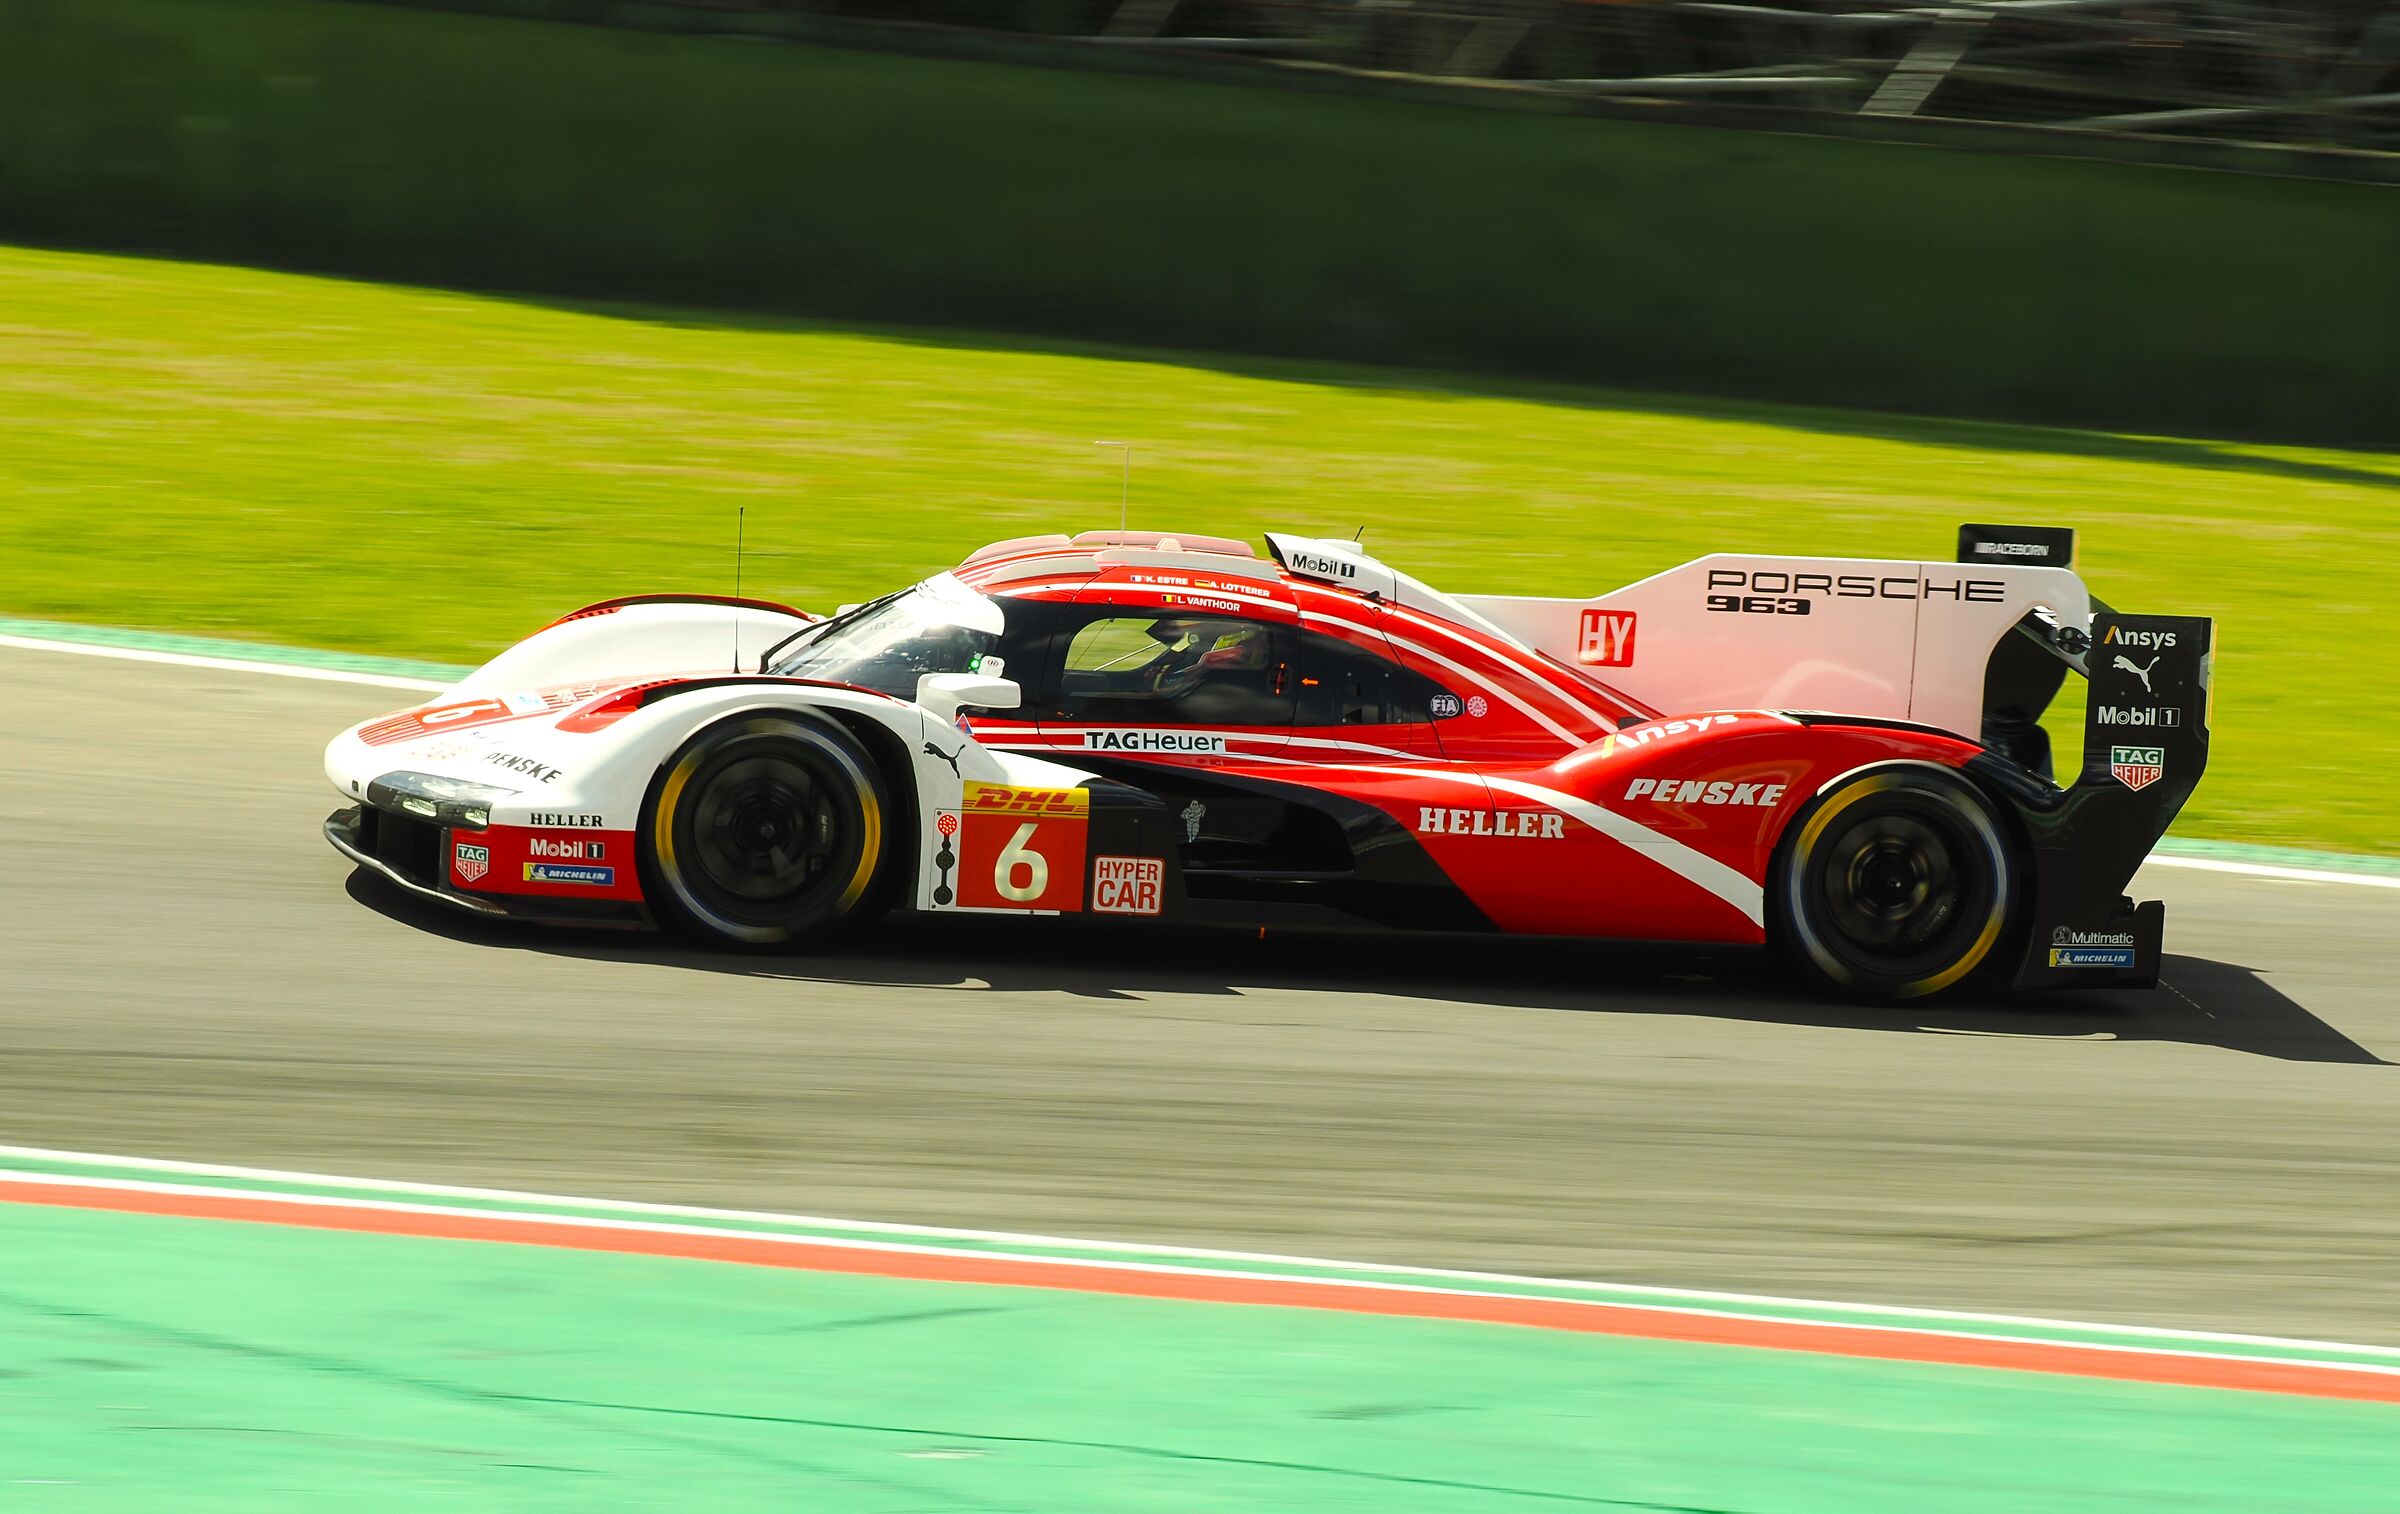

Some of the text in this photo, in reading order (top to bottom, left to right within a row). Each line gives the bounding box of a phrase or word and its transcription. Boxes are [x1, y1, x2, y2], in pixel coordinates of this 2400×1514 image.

[1292, 553, 1338, 575] Mobil
[1146, 575, 1270, 598] K. ESTRE A. LOTTERER
[1708, 570, 2005, 603] PORSCHE
[1177, 596, 1240, 612] L. VANTHOOR
[1706, 595, 1811, 616] 963
[1581, 614, 1635, 663] HY
[2104, 625, 2177, 651] Ansys
[1431, 699, 1457, 713] FIA
[2098, 706, 2156, 726] Mobil
[1601, 714, 1739, 760] Ansys
[2116, 749, 2159, 764] TAG
[483, 752, 563, 784] PENSKE
[2114, 765, 2159, 788] HEUER
[973, 788, 1077, 813] DHL
[1623, 778, 1787, 807] PENSKE
[530, 812, 604, 828] HELLER
[1418, 806, 1565, 839] HELLER
[459, 847, 486, 861] TAG
[530, 838, 583, 859] Mobil
[456, 859, 487, 878] HEUER
[994, 822, 1049, 902] 6
[1099, 860, 1159, 881] HYPER
[547, 869, 606, 881] MICHELIN
[1097, 879, 1157, 910] CAR
[2071, 932, 2134, 944] Multimatic
[2073, 954, 2127, 963] MICHELIN
